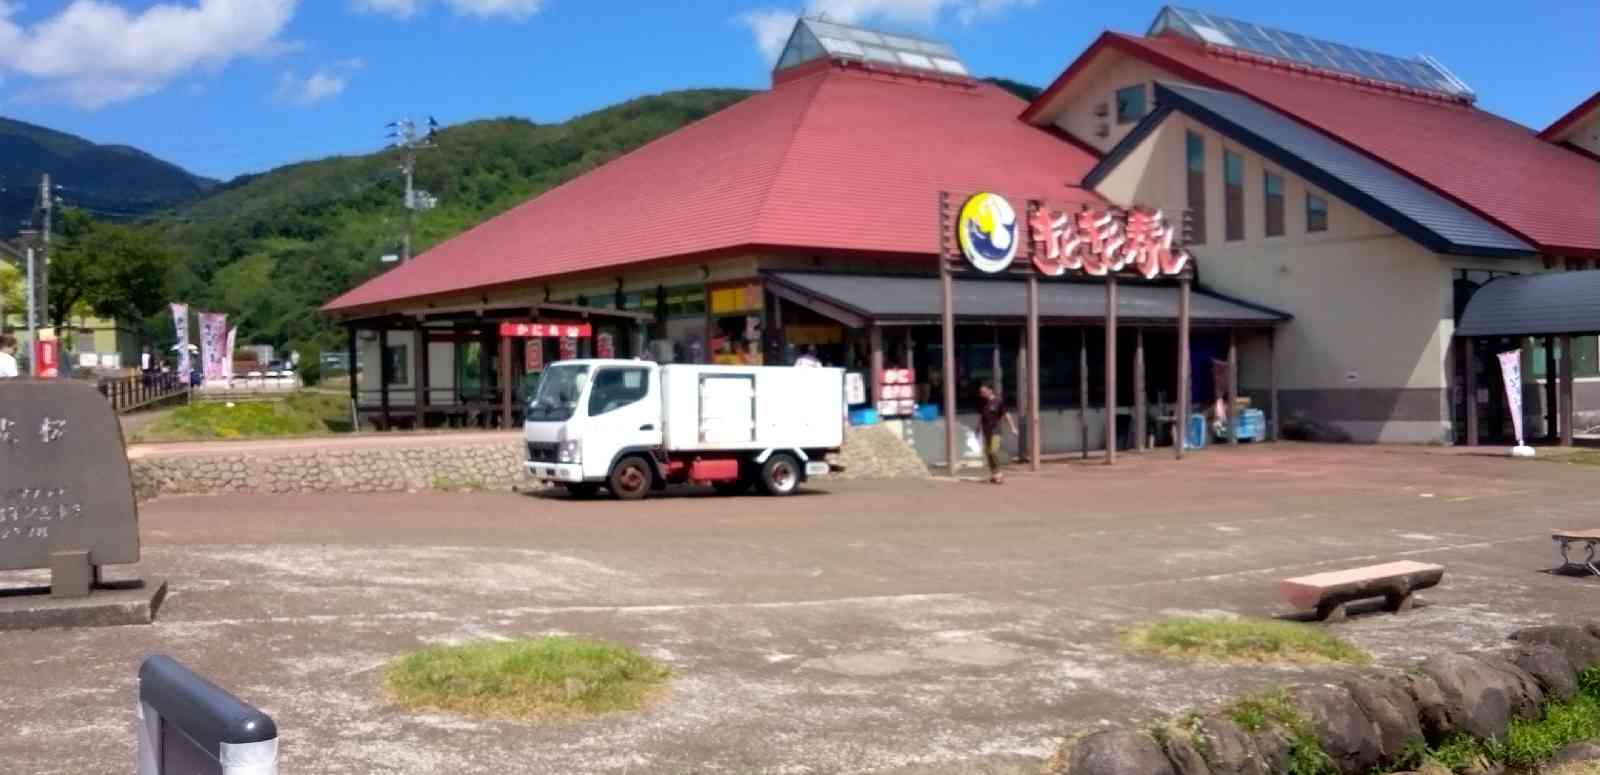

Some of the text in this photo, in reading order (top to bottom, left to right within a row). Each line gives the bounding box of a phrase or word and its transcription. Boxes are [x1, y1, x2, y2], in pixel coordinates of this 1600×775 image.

[1029, 206, 1188, 279] きときと寿し
